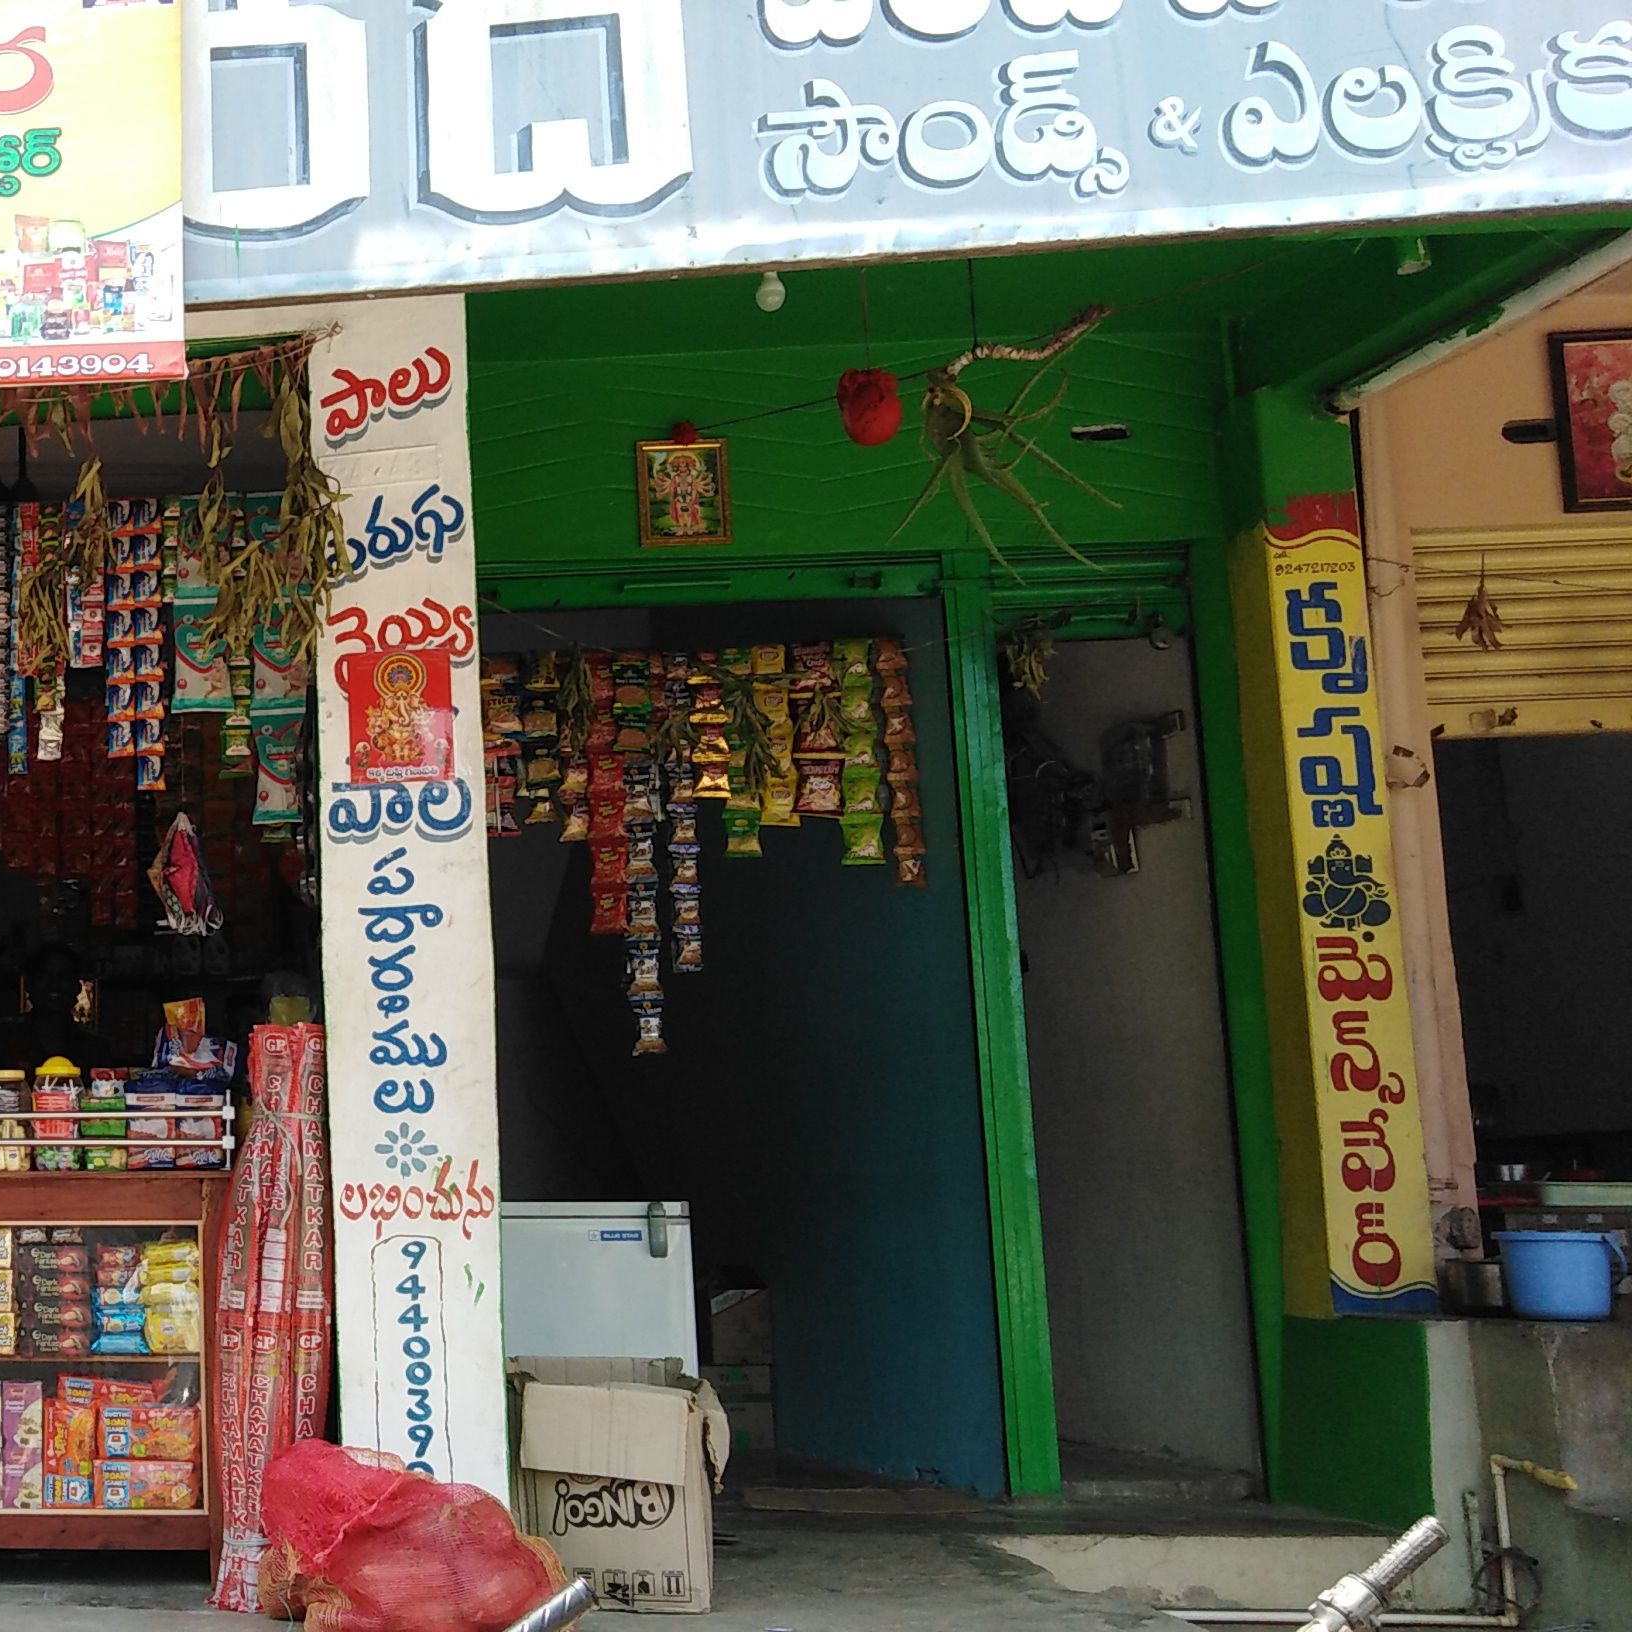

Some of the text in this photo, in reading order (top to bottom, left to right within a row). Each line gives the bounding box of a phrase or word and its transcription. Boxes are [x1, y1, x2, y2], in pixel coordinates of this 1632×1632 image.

[1149, 96, 1202, 152] &
[320, 347, 452, 438] పాలు
[1275, 561, 1356, 577] 9247217203
[304, 1076, 324, 1271] CHAMATKAR
[254, 1335, 276, 1350] GP
[299, 1333, 322, 1349] GP
[553, 1479, 673, 1537] BINGO!
